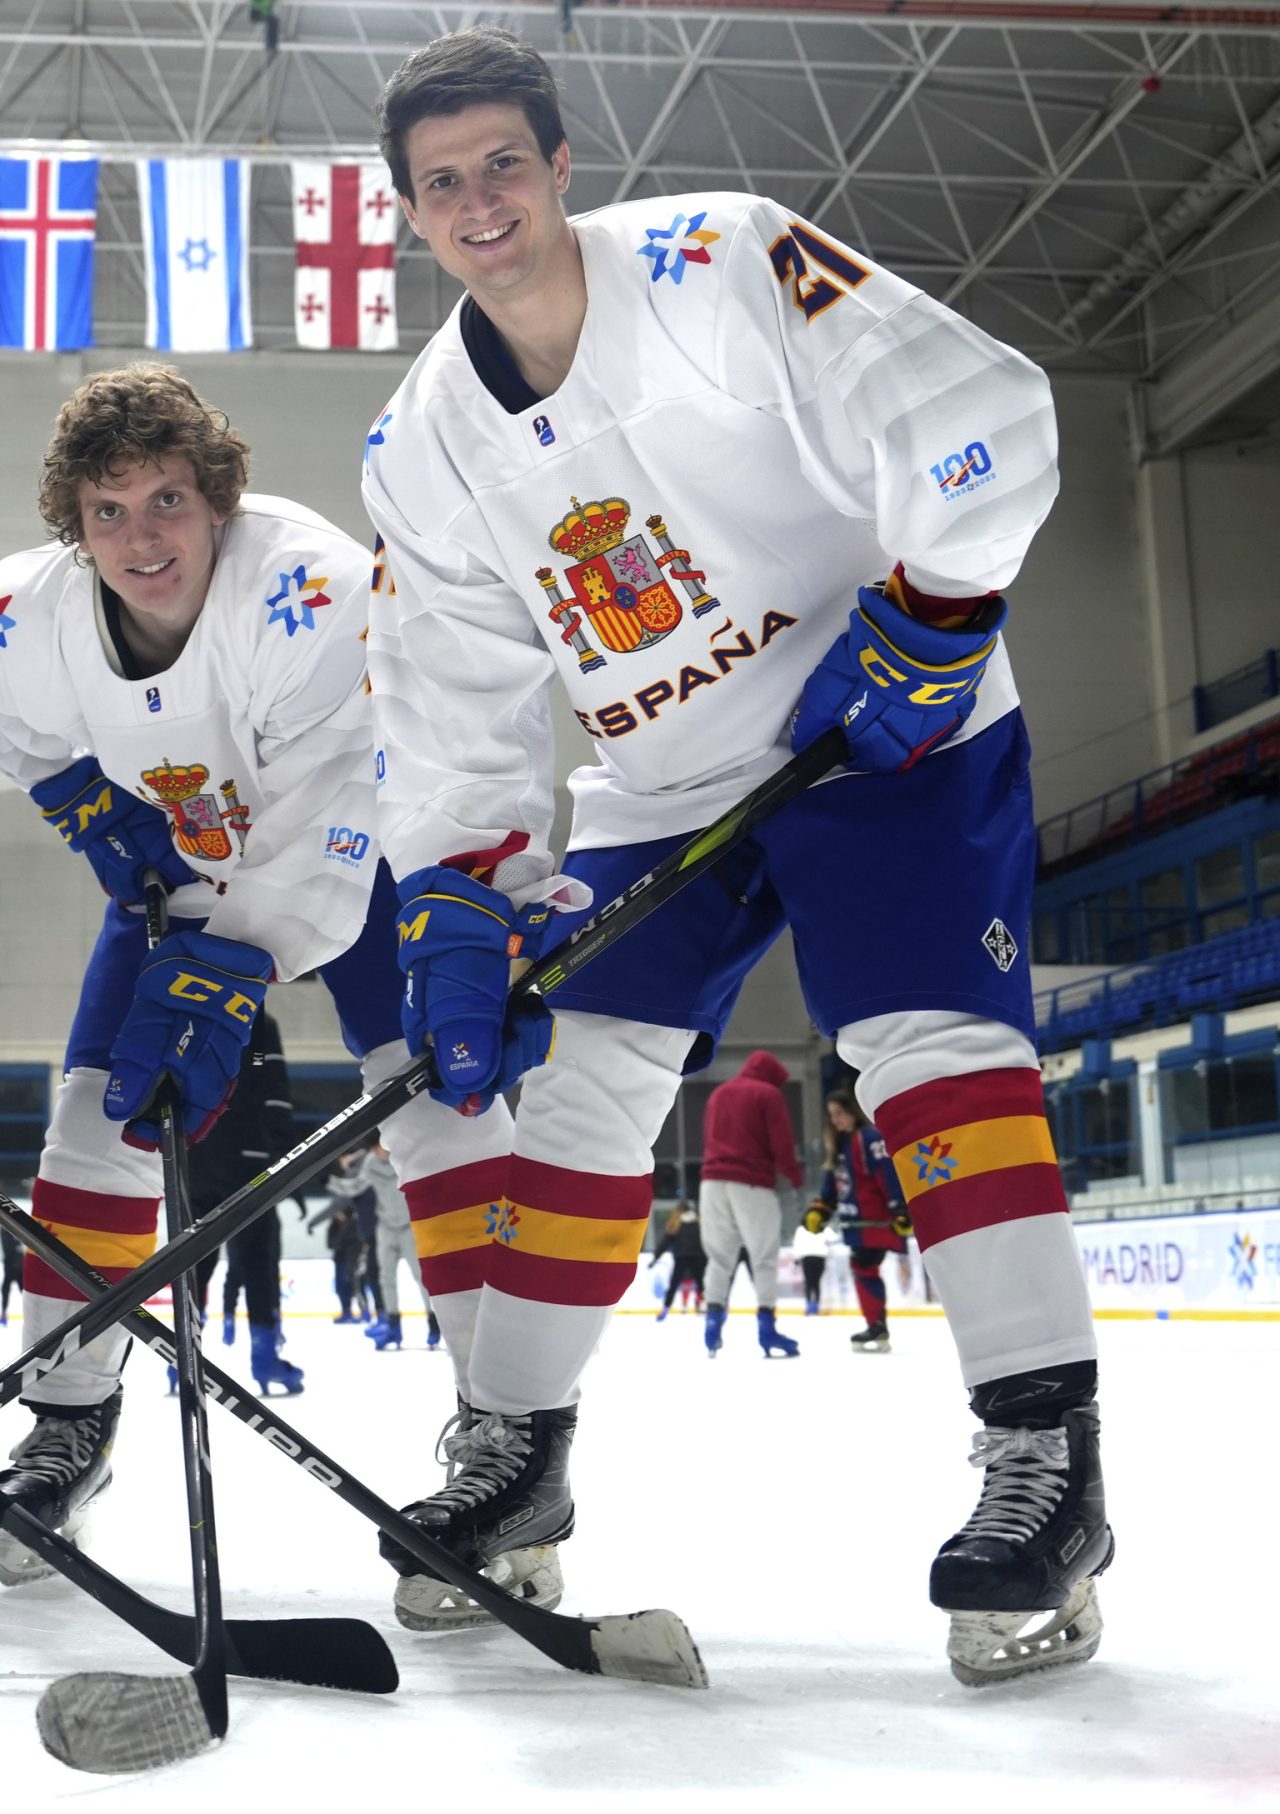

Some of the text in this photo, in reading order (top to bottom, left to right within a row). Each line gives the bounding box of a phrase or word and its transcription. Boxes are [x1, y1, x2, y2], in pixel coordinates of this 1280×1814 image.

[768, 222, 873, 326] 21
[929, 441, 992, 494] 100
[859, 642, 988, 706] CC
[324, 826, 370, 860] 100
[1083, 1241, 1185, 1285] MADRID
